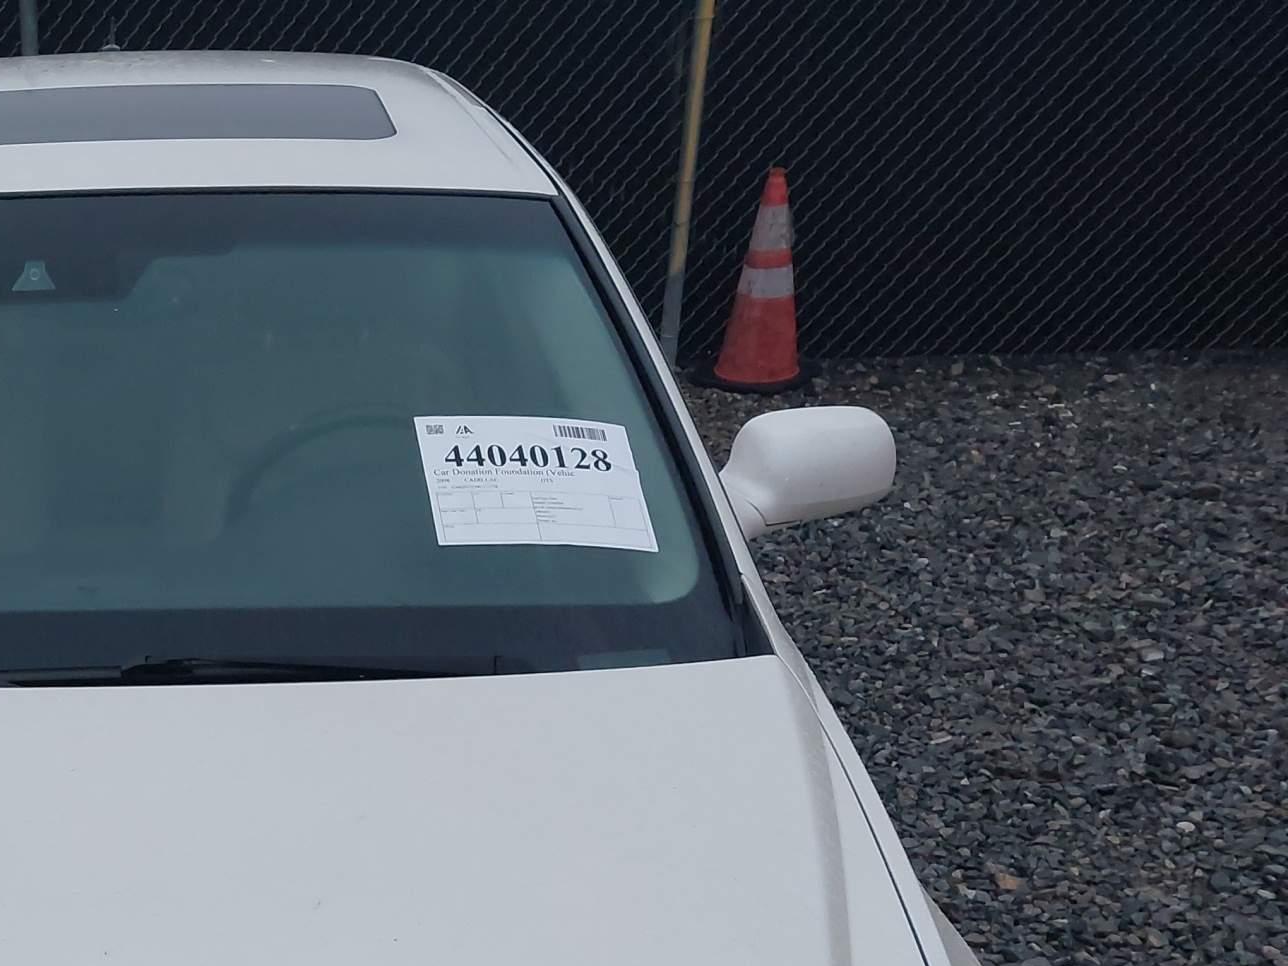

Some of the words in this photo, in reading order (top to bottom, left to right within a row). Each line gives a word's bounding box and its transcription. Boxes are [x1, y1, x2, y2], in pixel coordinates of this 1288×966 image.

[444, 444, 612, 472] 44040128
[433, 468, 449, 476] Car
[452, 468, 493, 476] Donation
[495, 468, 543, 477] Foundation
